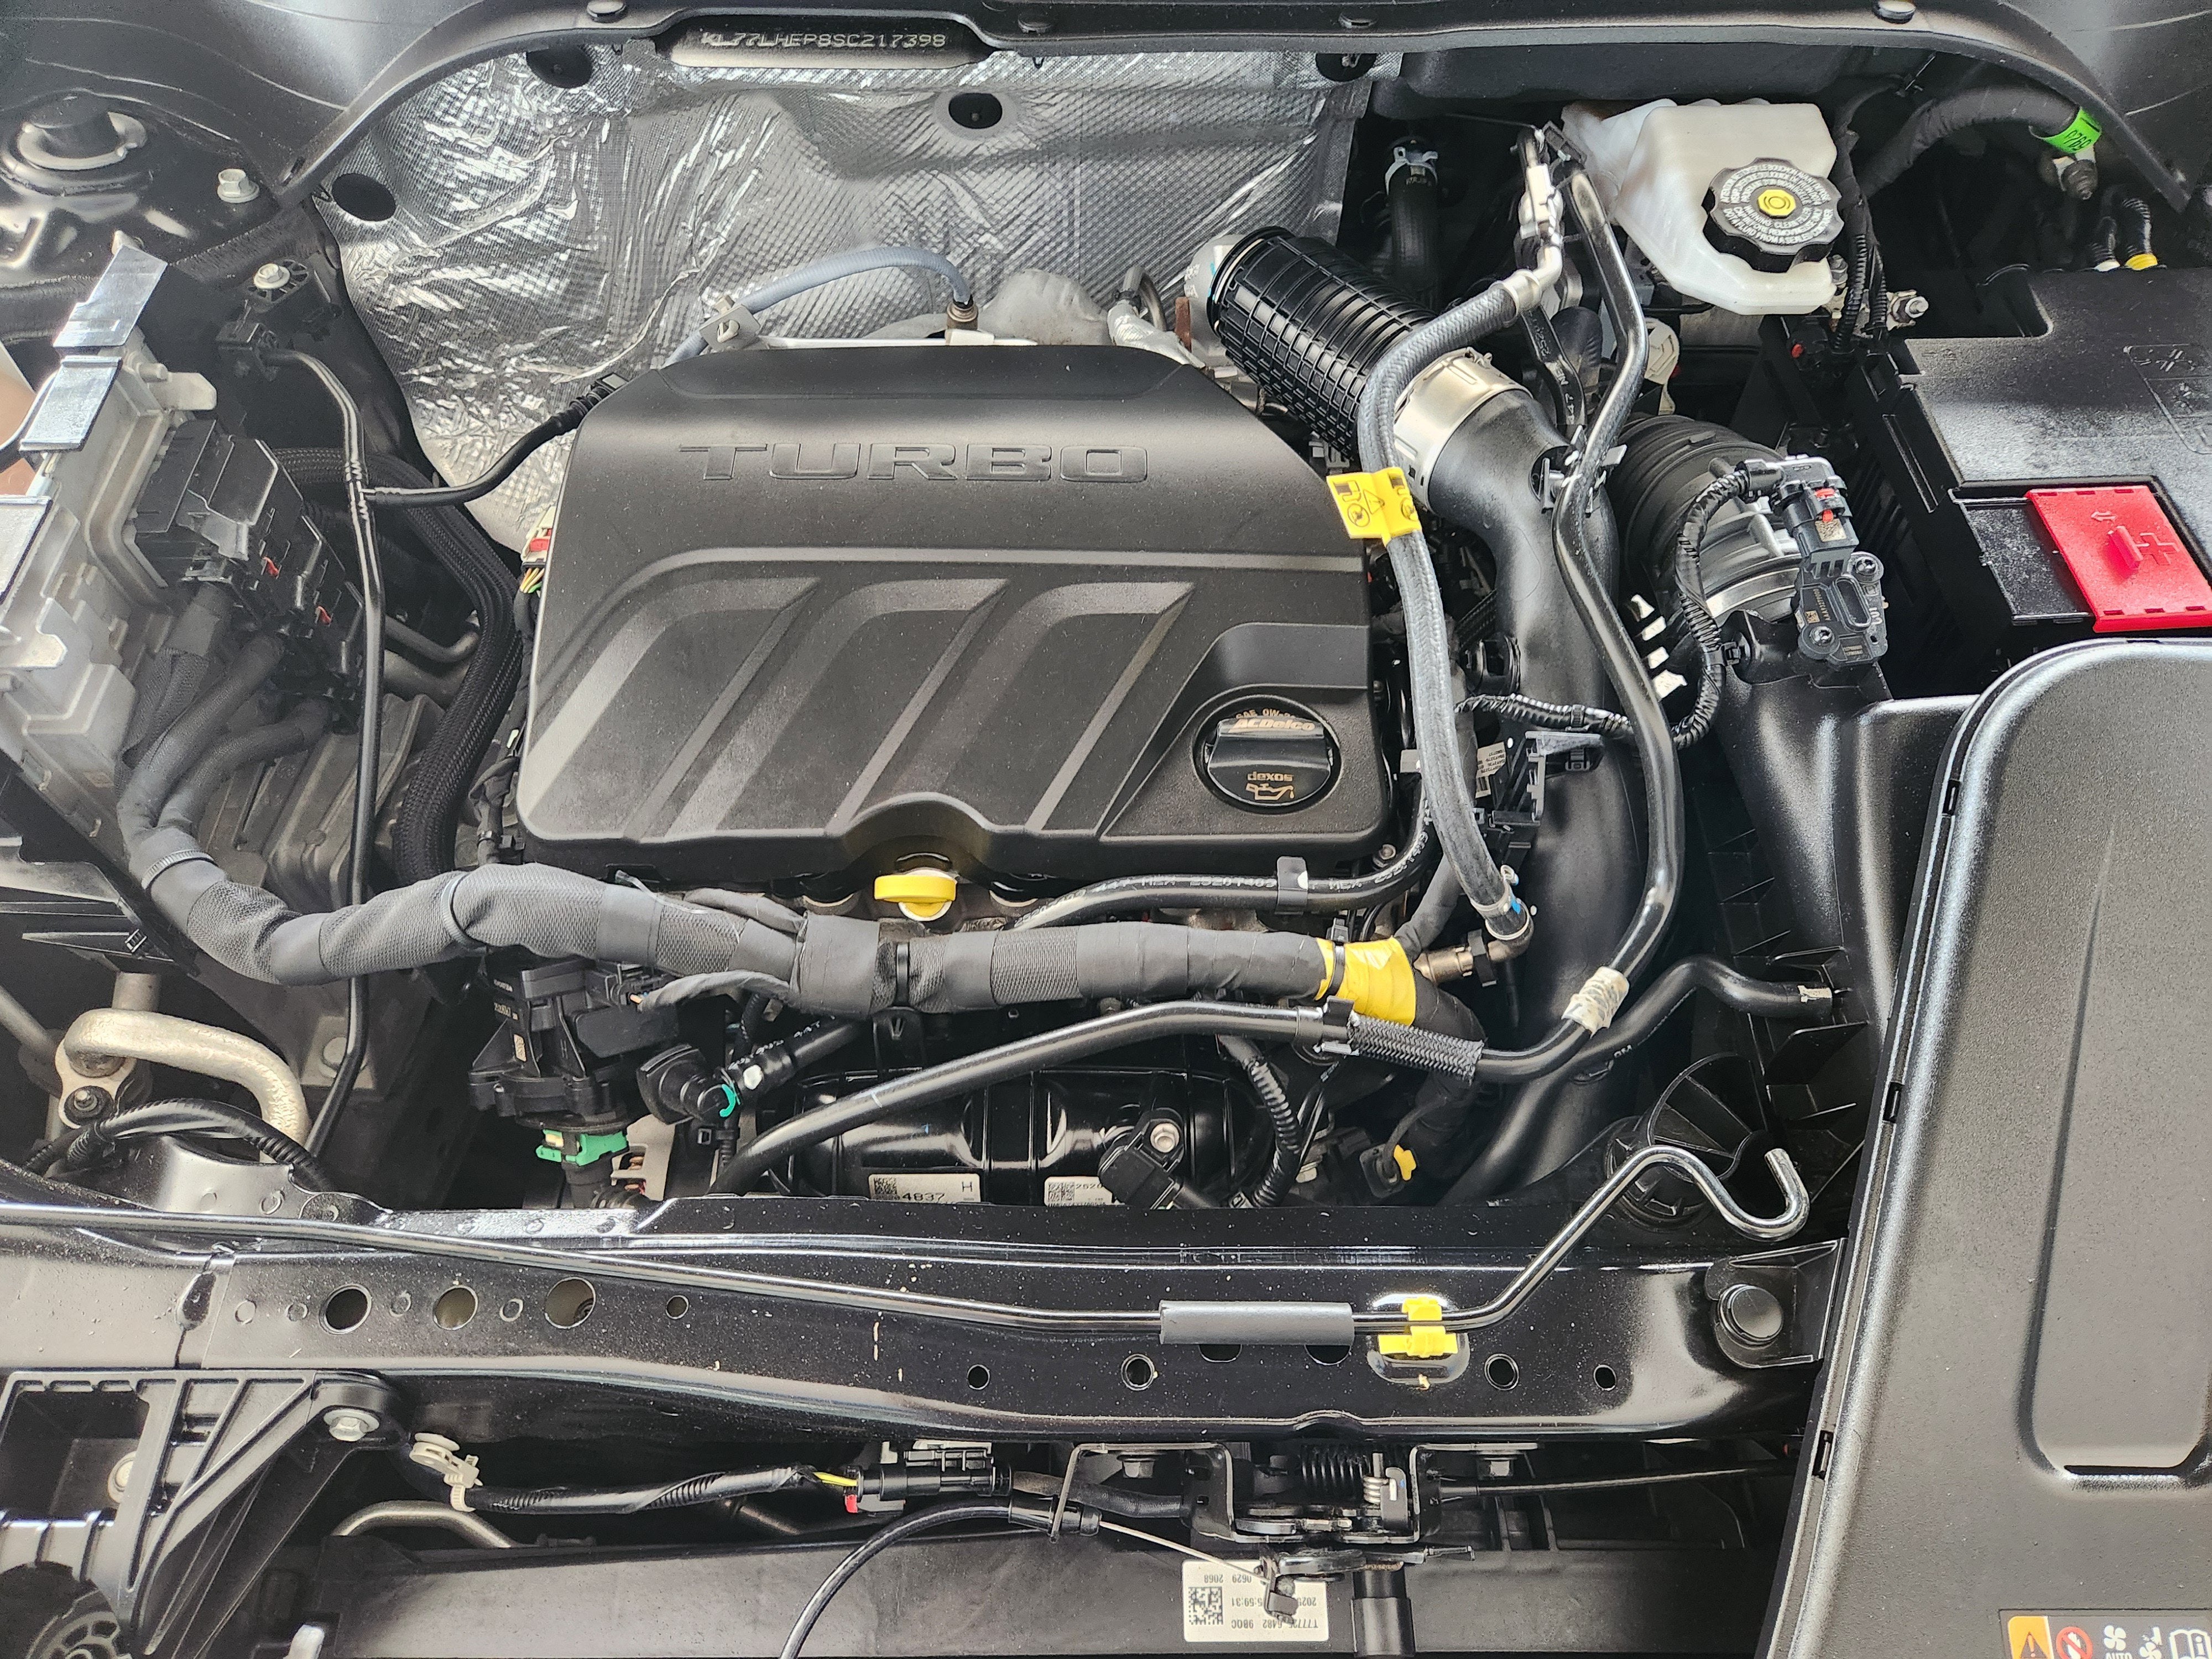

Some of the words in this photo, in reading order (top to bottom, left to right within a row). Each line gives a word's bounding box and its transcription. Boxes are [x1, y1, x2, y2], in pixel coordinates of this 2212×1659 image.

[678, 442, 1148, 483] TURBO
[1235, 709, 1258, 719] SAE
[1228, 718, 1316, 733] ACDelco
[1247, 771, 1293, 782] dexos
[962, 1181, 973, 1193] H
[1203, 1574, 1224, 1584] 2068
